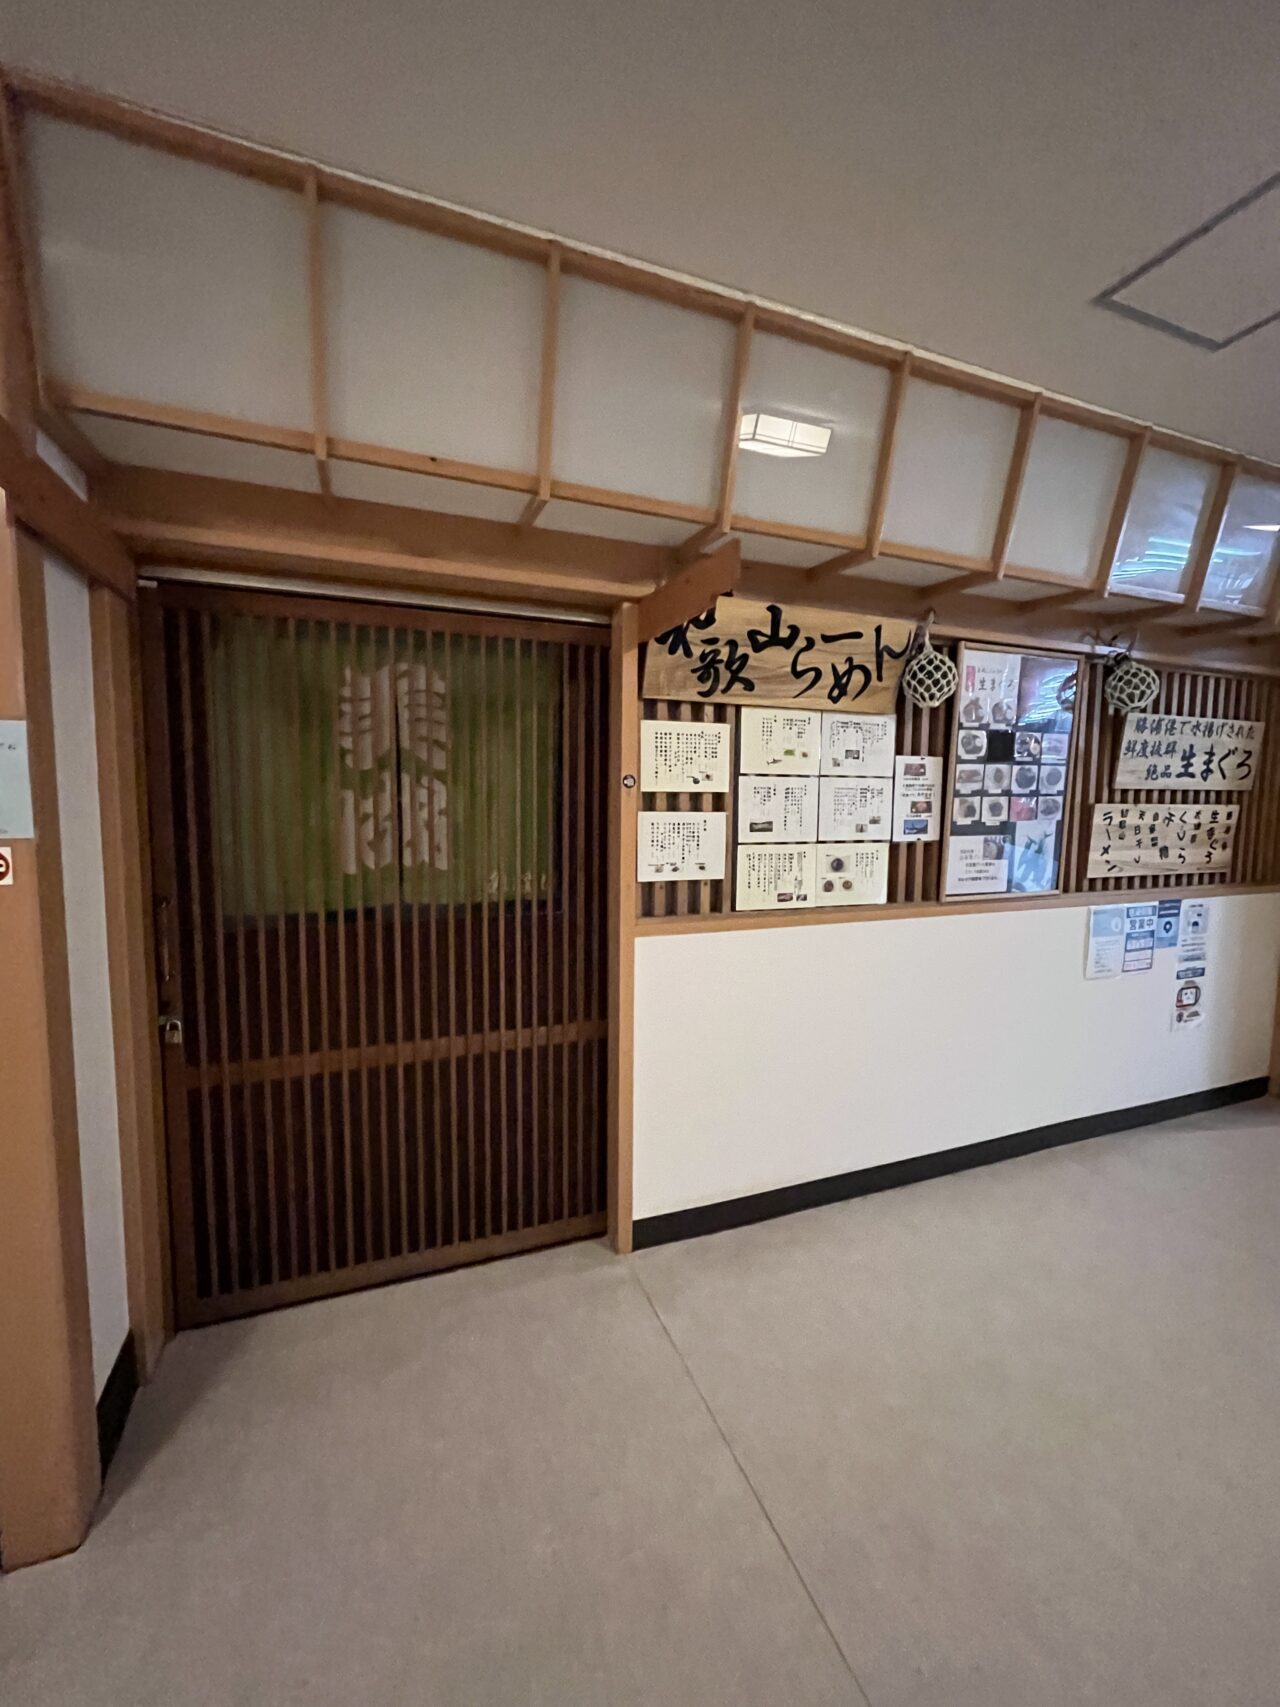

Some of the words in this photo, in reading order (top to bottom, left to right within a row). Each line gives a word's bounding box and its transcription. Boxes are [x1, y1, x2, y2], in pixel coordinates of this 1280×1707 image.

[1175, 743, 1252, 782] 生まぐろ
[1100, 811, 1117, 873] ラーメン
